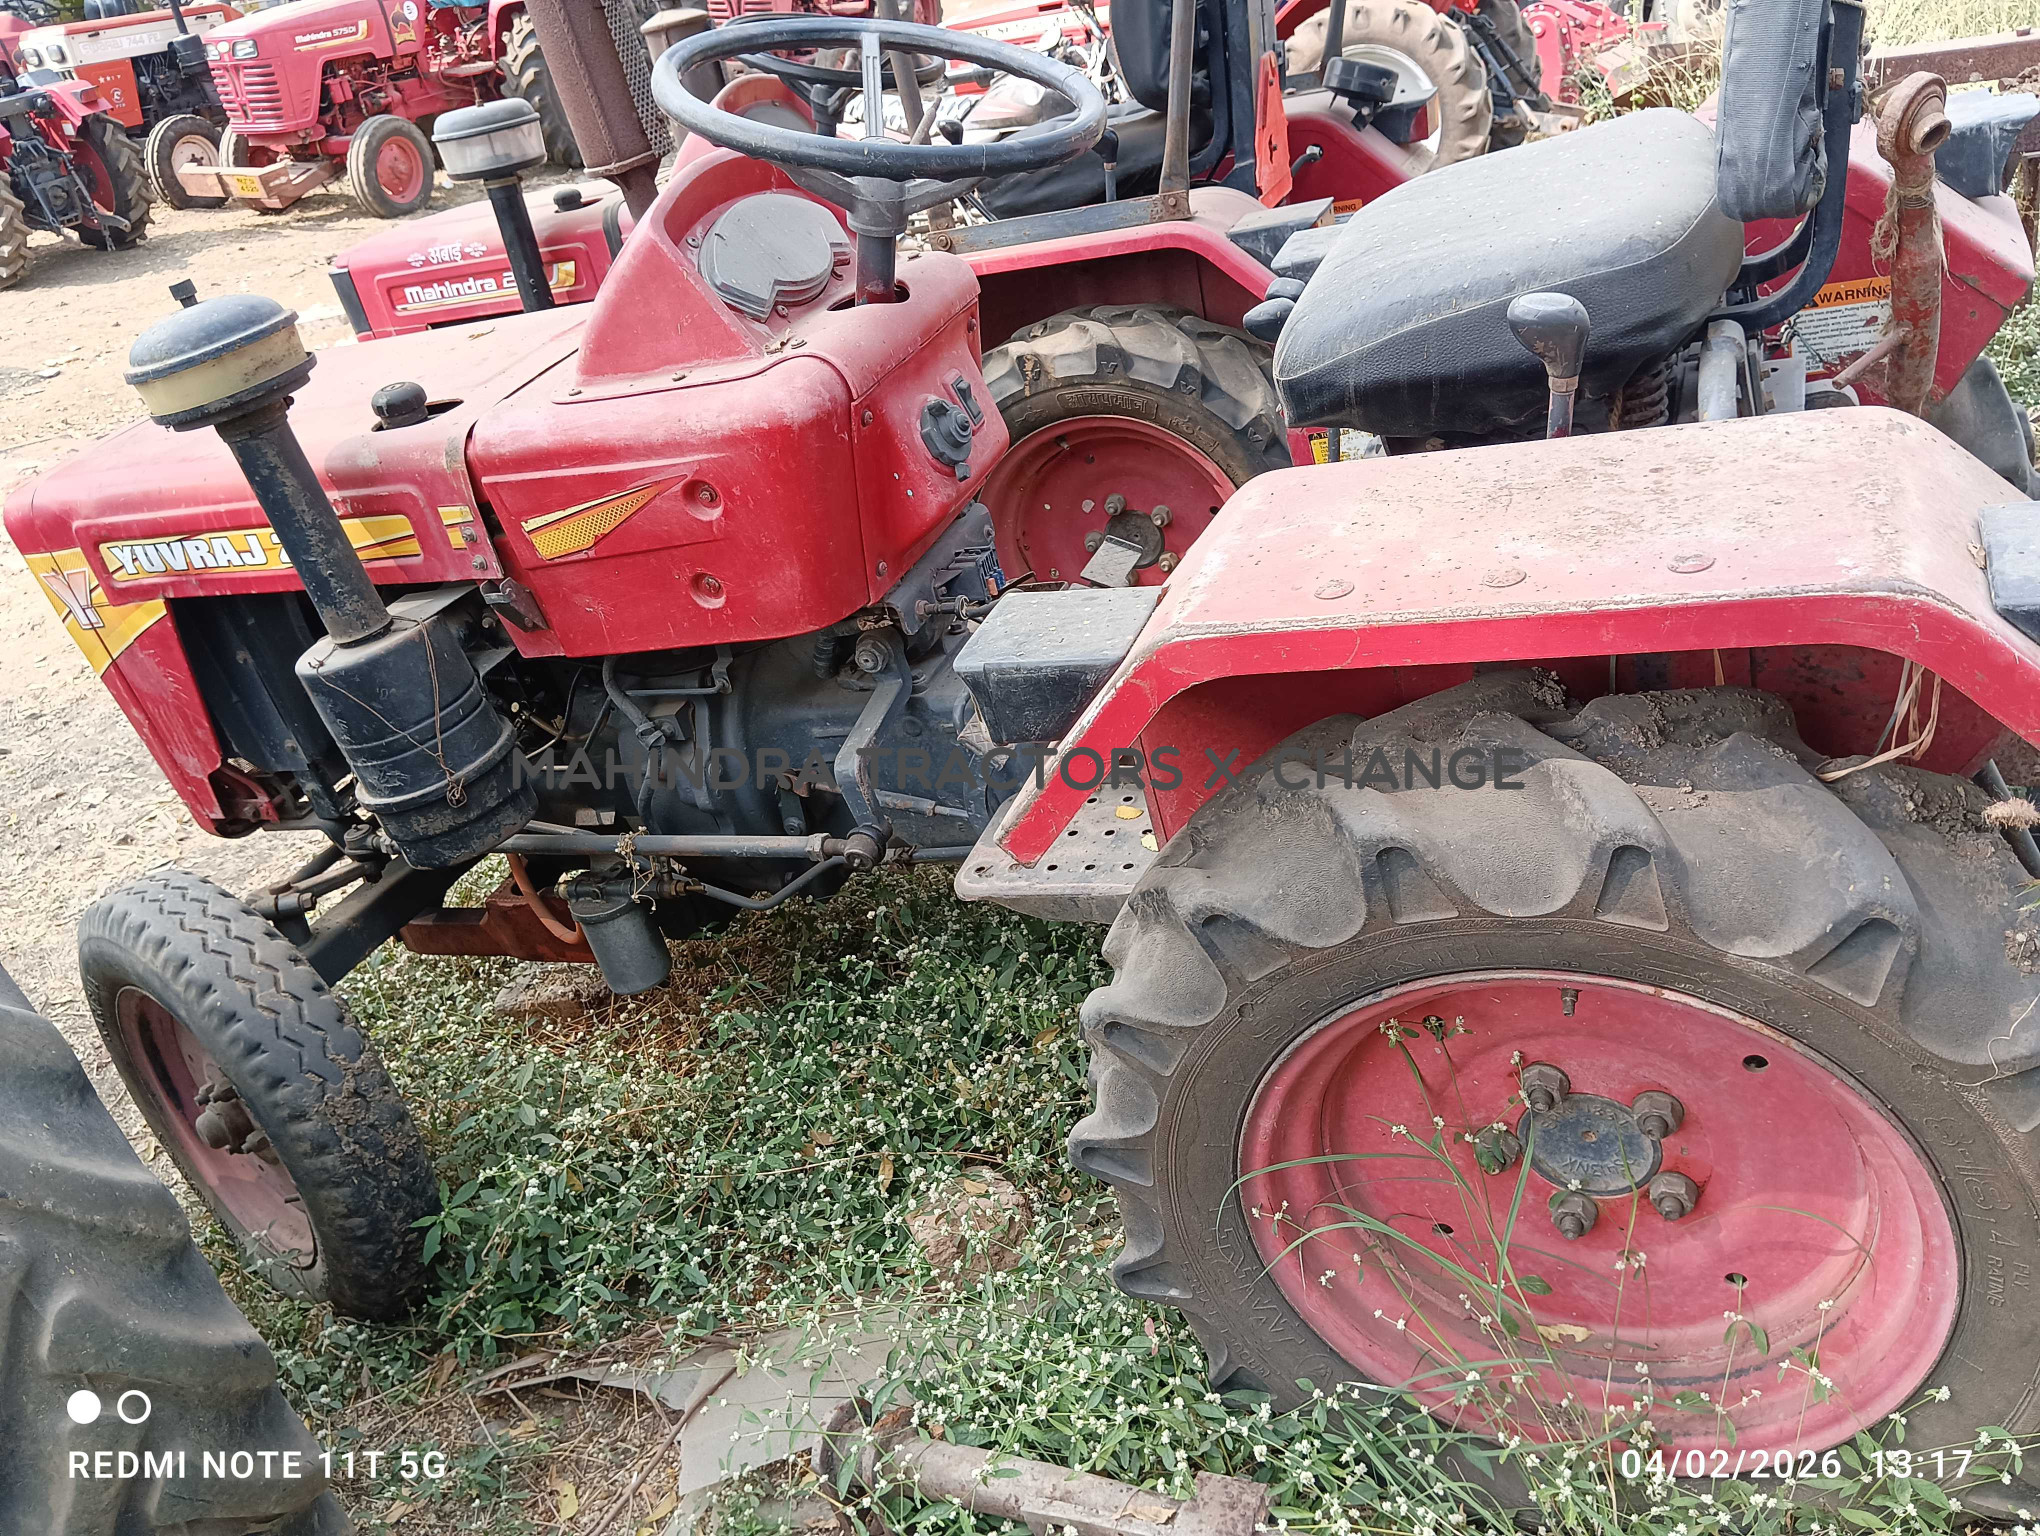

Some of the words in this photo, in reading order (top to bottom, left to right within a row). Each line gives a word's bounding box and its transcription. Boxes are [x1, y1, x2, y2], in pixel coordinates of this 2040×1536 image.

[295, 31, 332, 44] Mahindra
[1333, 203, 1357, 213] RNING
[403, 277, 498, 304] Mahindra
[107, 533, 268, 576] YUVRAJ
[1986, 1253, 2008, 1309] RATING
